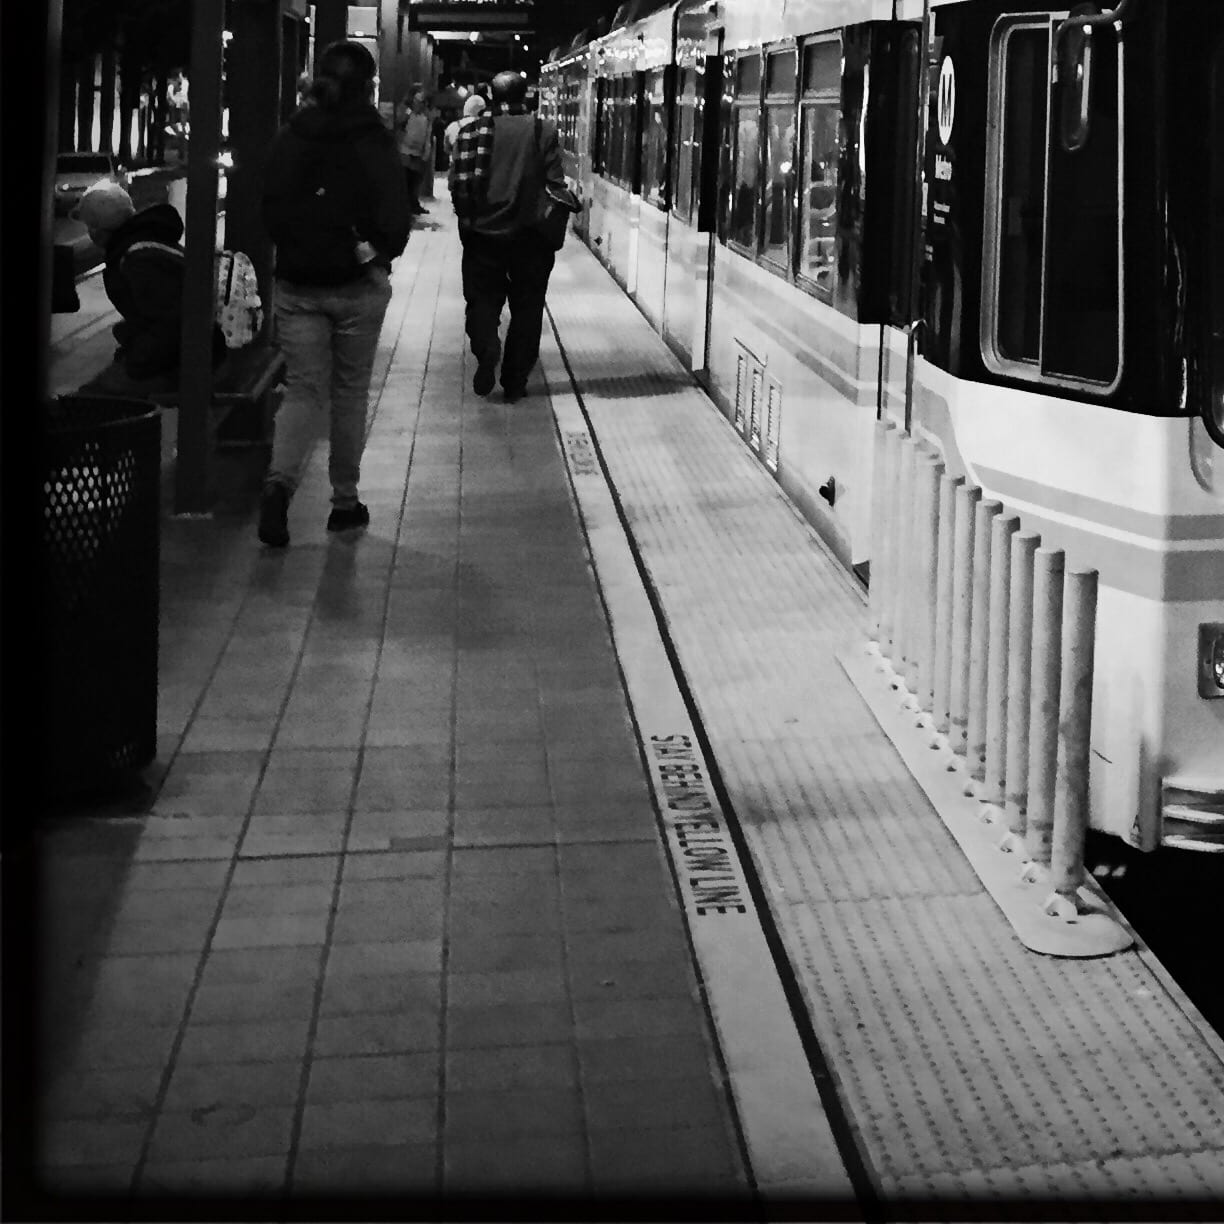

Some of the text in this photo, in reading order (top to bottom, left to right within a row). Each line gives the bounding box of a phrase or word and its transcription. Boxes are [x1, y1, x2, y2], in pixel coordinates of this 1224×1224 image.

[651, 734, 747, 916] STAY BEHIND YELLOW LINE
